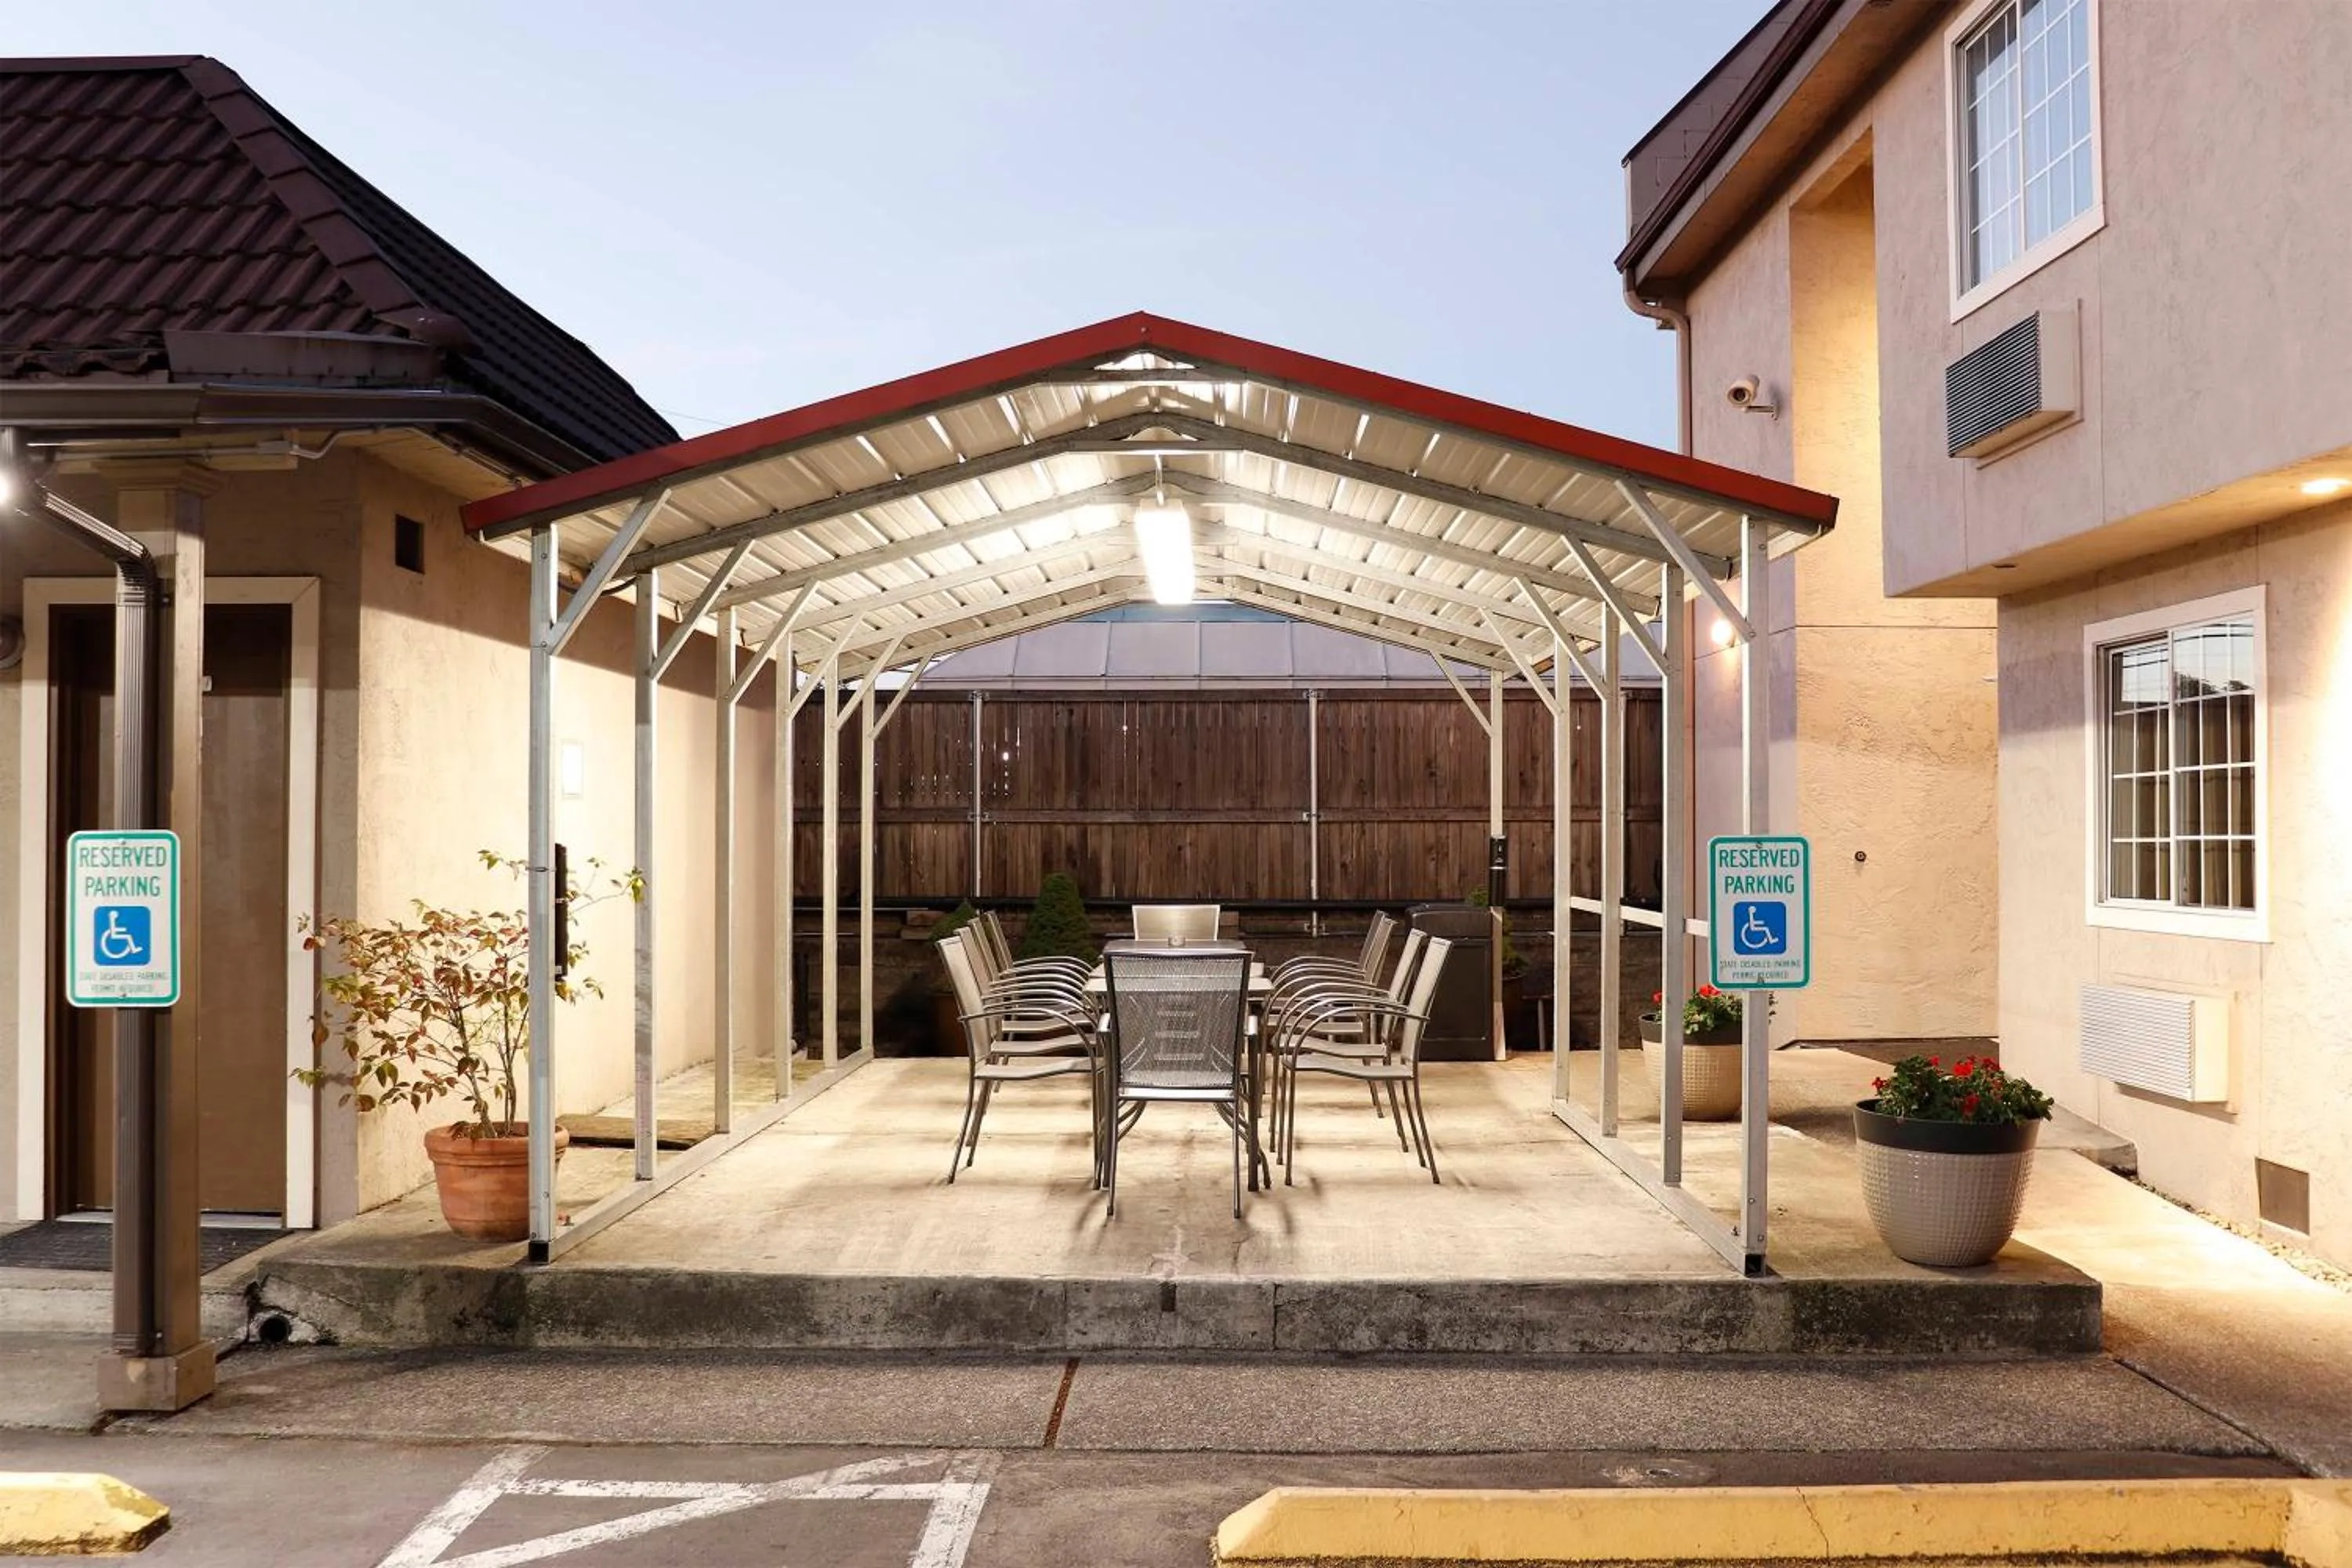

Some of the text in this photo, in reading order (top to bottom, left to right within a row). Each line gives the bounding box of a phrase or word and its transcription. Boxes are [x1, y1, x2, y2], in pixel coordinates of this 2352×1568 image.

[79, 846, 167, 868] RESERVED
[1719, 849, 1800, 868] RESERVED
[85, 876, 161, 897] PARKING
[1725, 875, 1795, 895] PARKING
